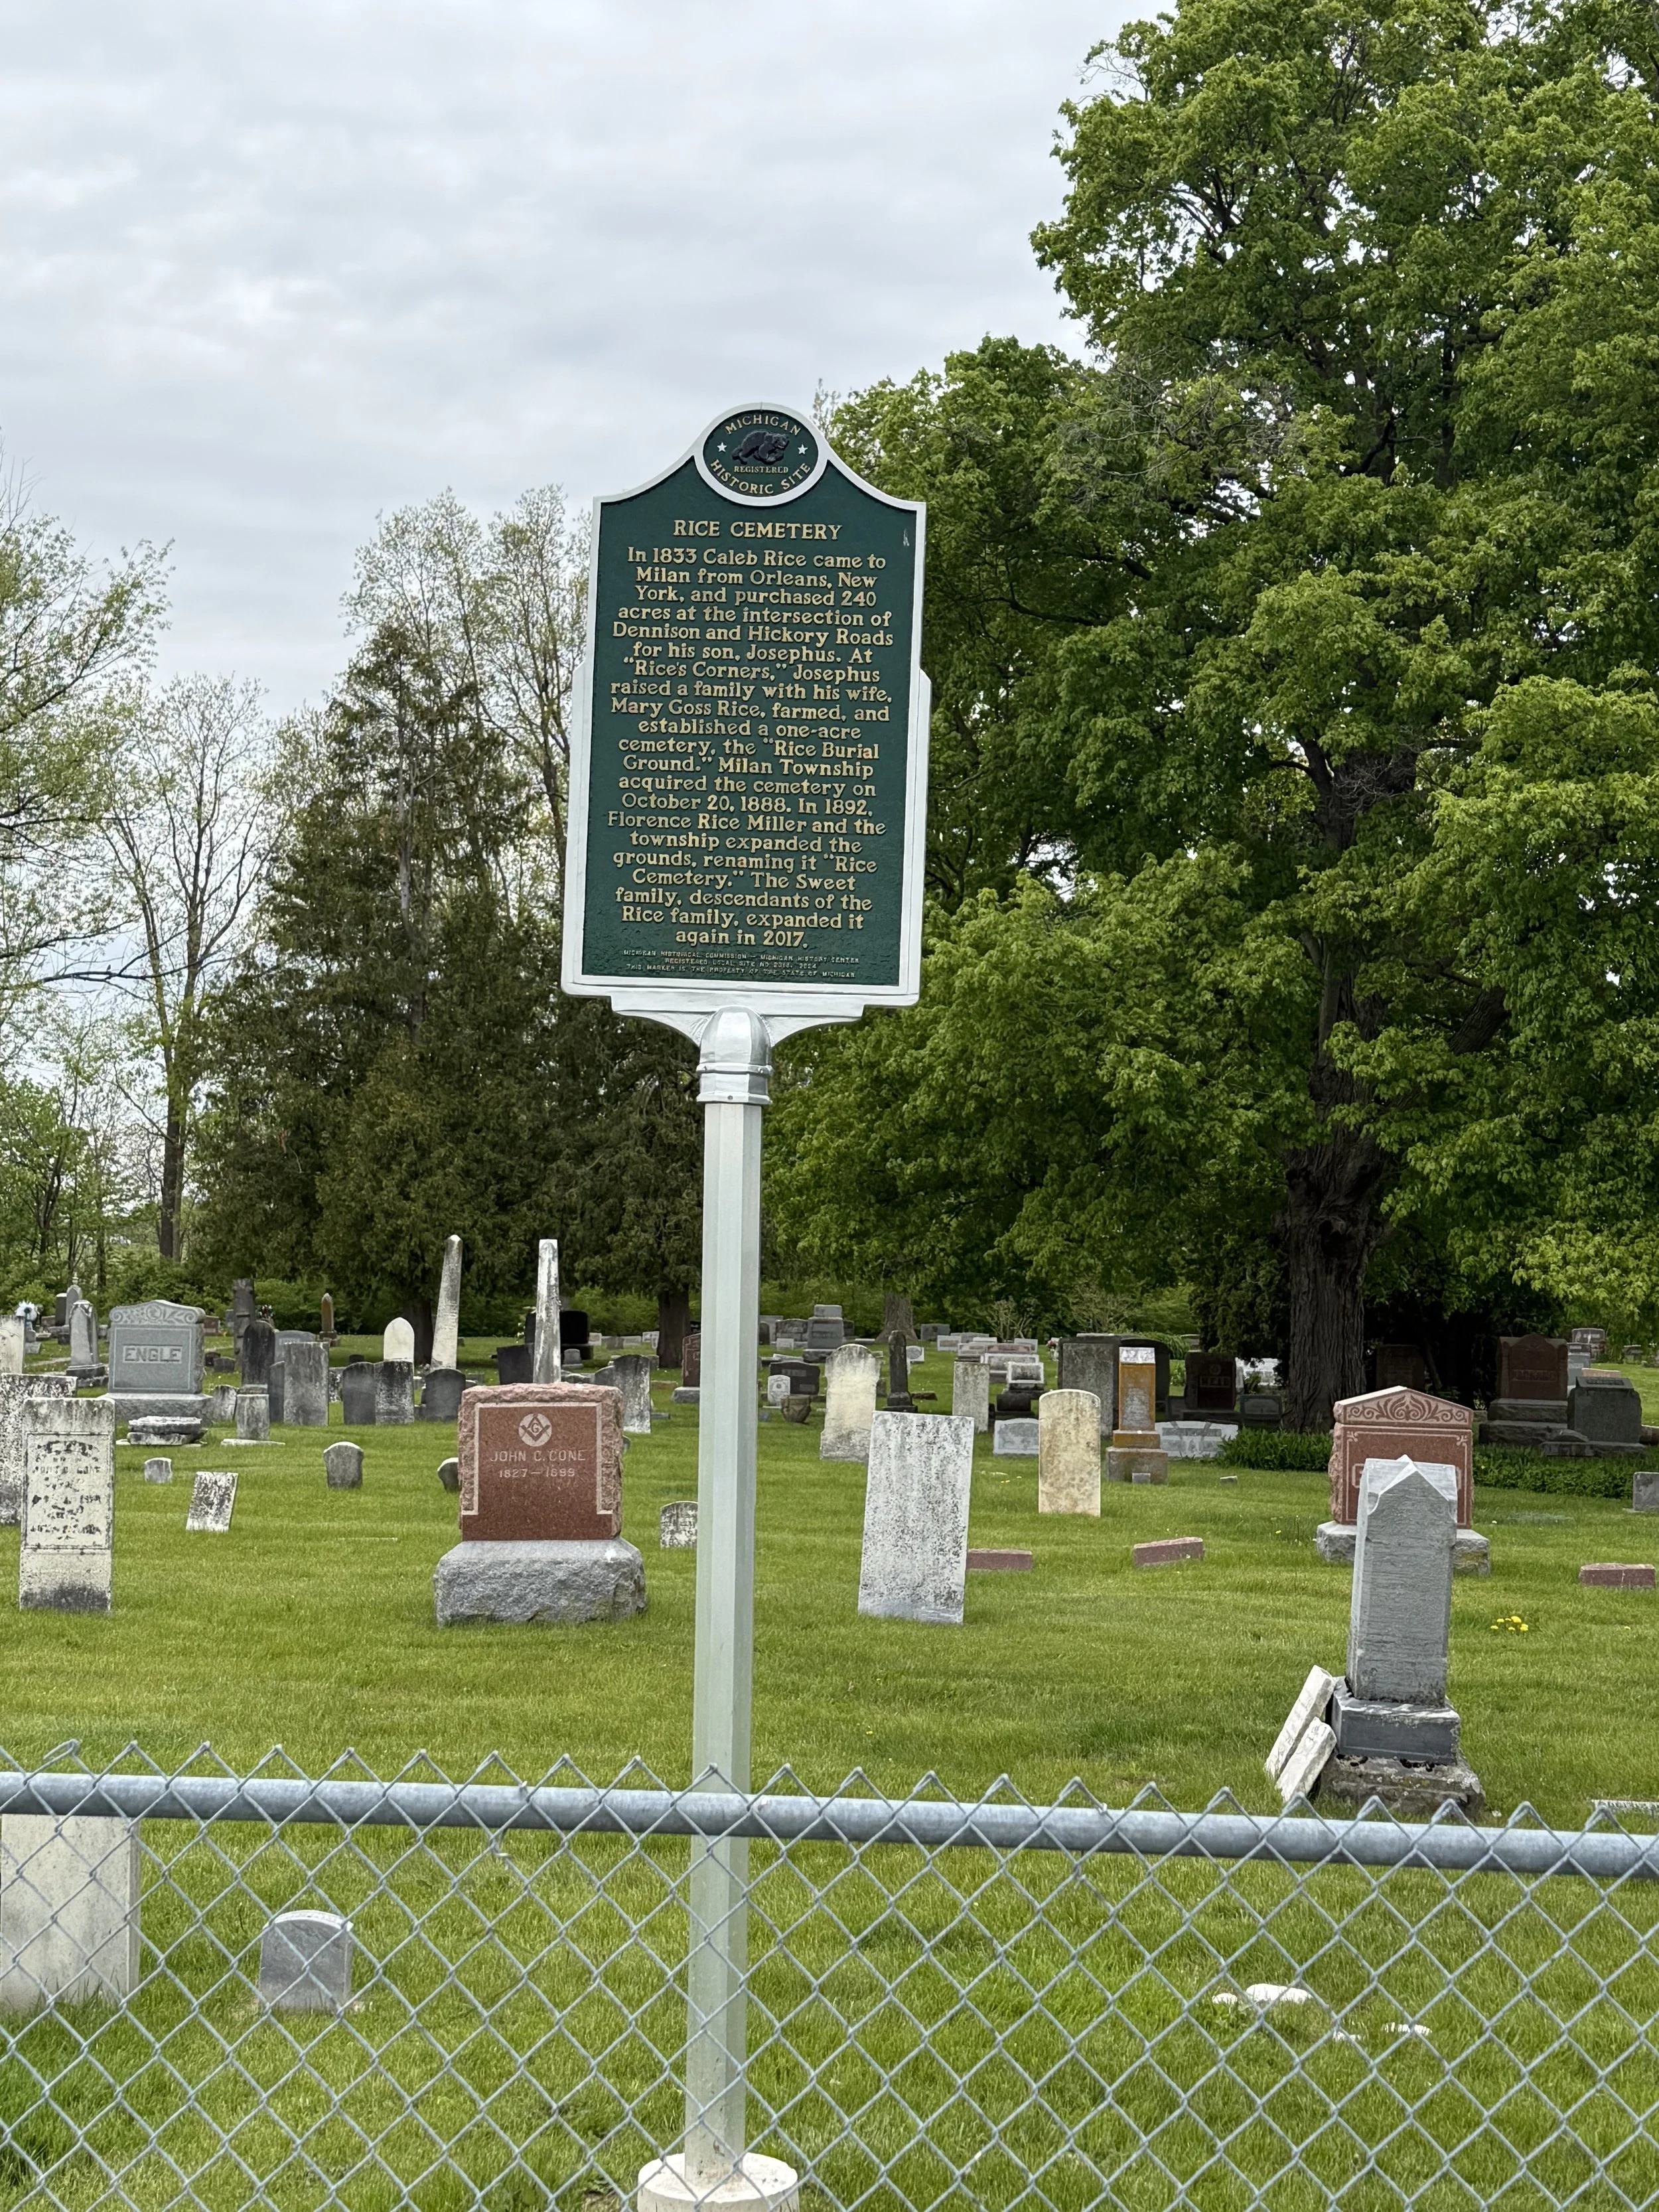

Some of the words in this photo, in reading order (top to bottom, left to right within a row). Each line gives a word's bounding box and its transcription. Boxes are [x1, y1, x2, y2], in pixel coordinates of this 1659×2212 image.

[724, 414, 802, 435] MICHIGAN
[710, 459, 774, 495] HISTORIC
[780, 463, 811, 490] SITE
[733, 465, 789, 474] REGISTERED
[673, 520, 720, 536] RICE
[730, 522, 842, 540] CEMETERY
[628, 546, 647, 562] In
[652, 548, 697, 563] 1833
[703, 548, 758, 565] Caleb
[763, 550, 807, 566] Rice
[813, 555, 863, 568] came
[867, 553, 886, 569] to
[636, 566, 691, 583] Milan
[697, 567, 743, 584] from
[750, 569, 832, 589] Orleans,
[837, 571, 878, 587] New
[634, 585, 684, 603] York,
[690, 587, 727, 602] and
[735, 588, 835, 606] purchased
[841, 590, 877, 607] 240
[618, 607, 671, 619] acres
[676, 605, 697, 621] at
[703, 606, 737, 621] the
[743, 607, 864, 626] intersection
[870, 611, 892, 627] of
[613, 621, 701, 639] Dennison
[705, 625, 741, 640] and
[748, 625, 830, 648] Hickory
[835, 628, 893, 646] Roads
[632, 641, 662, 657] for
[668, 642, 695, 658] his
[702, 646, 741, 661] son,
[746, 644, 841, 664] Josephus.
[848, 648, 873, 664] At
[793, 664, 880, 685] Josephus
[611, 679, 671, 696] raised
[677, 684, 688, 696] a
[693, 680, 755, 701] family
[761, 683, 806, 699] with
[813, 684, 840, 700] his
[845, 686, 892, 703] wife,
[611, 697, 664, 718] Mary
[668, 699, 711, 715] Goss
[717, 700, 766, 718] Rice,
[772, 701, 846, 721] farmed,
[854, 705, 890, 721] and
[638, 717, 751, 735] established
[758, 724, 768, 736] a
[776, 725, 861, 739] one-acre
[618, 737, 715, 756] cemetery,
[722, 739, 756, 755] the
[822, 741, 879, 759] Burial
[718, 757, 773, 774] Milan
[778, 759, 873, 780] Township
[618, 774, 707, 792] acquired
[713, 776, 747, 792] the
[753, 778, 846, 798] cemetery
[853, 784, 877, 796] on
[622, 792, 701, 810] October
[707, 794, 735, 812] 20,
[741, 796, 792, 813] 1888.
[798, 798, 818, 814] In
[825, 798, 873, 817] 1892,
[608, 810, 691, 828] Florence
[697, 813, 741, 830] Rice
[747, 814, 807, 832] Miller
[812, 818, 847, 834] and
[853, 818, 887, 835] the
[630, 830, 720, 851] township
[725, 836, 822, 853] expanded
[828, 837, 863, 853] the
[613, 850, 697, 868] grounds,
[703, 853, 794, 873] renaming
[801, 855, 817, 871] it
[751, 871, 790, 889] The
[796, 873, 856, 891] Sweet
[615, 886, 682, 907] family,
[689, 889, 810, 908] descendants
[814, 894, 835, 909] of
[840, 894, 873, 911] the
[622, 905, 664, 922] Rice
[670, 907, 739, 928] family,
[746, 912, 841, 929] expanded
[849, 913, 864, 929] it
[676, 928, 730, 946] again
[737, 929, 756, 945] in
[762, 930, 808, 948] 2017.
[124, 1347, 182, 1363] ENGLE
[490, 1450, 527, 1462] JOHN
[533, 1450, 546, 1461] C.
[549, 1449, 587, 1461] CONE
